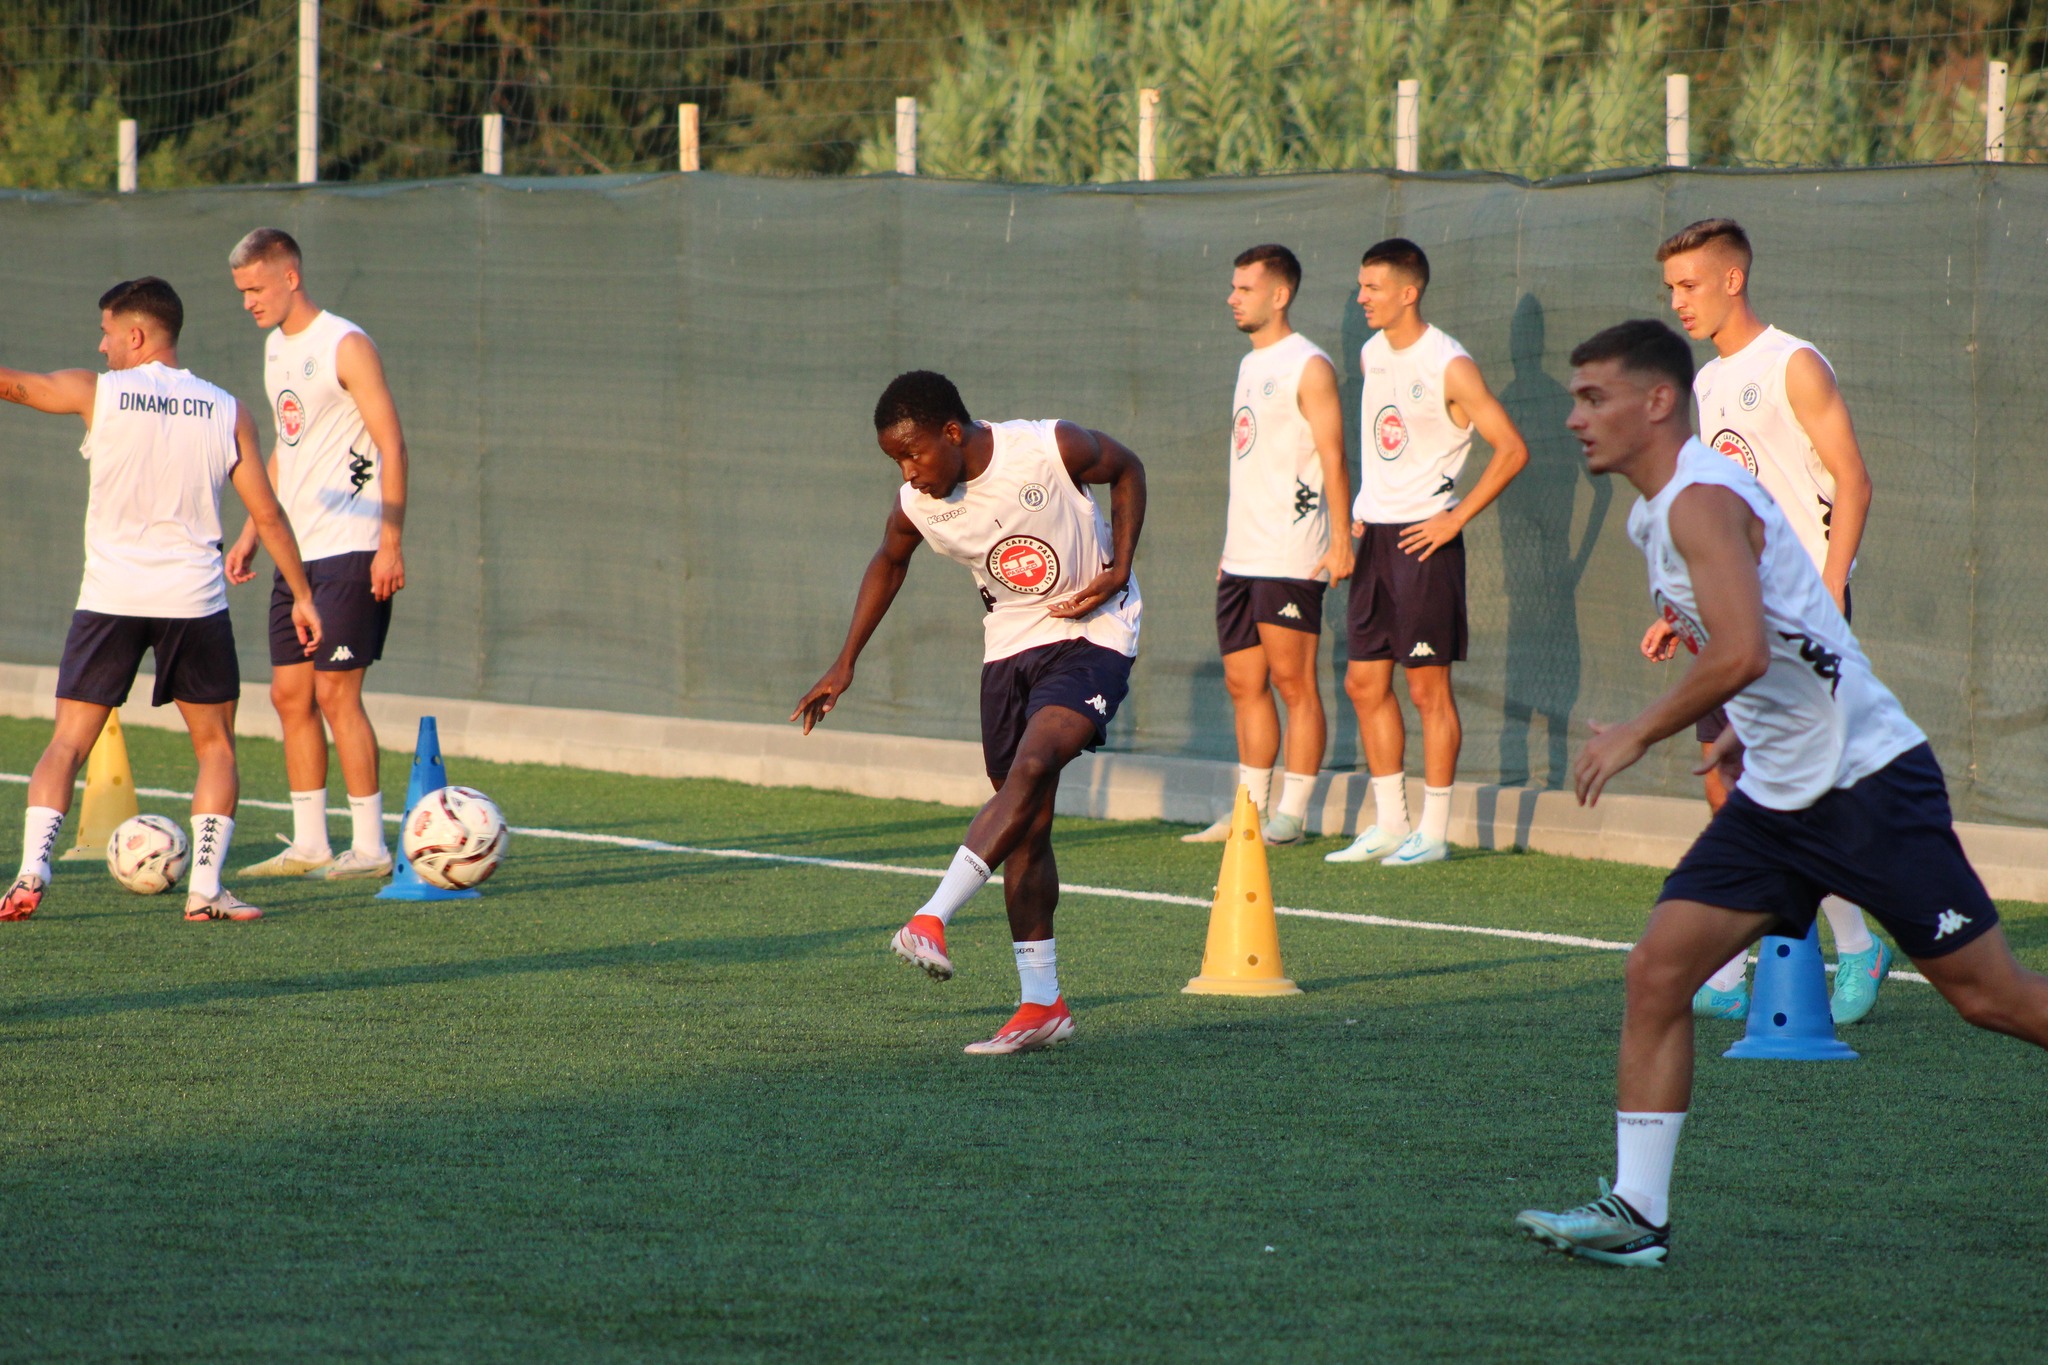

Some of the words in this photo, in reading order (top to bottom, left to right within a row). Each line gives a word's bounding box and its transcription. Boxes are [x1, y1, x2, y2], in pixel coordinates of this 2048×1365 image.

[120, 392, 178, 415] DINAMO
[183, 398, 215, 419] CITY
[927, 507, 967, 525] Kappa
[994, 519, 1002, 528] 1
[1036, 545, 1055, 585] PASCUCCI
